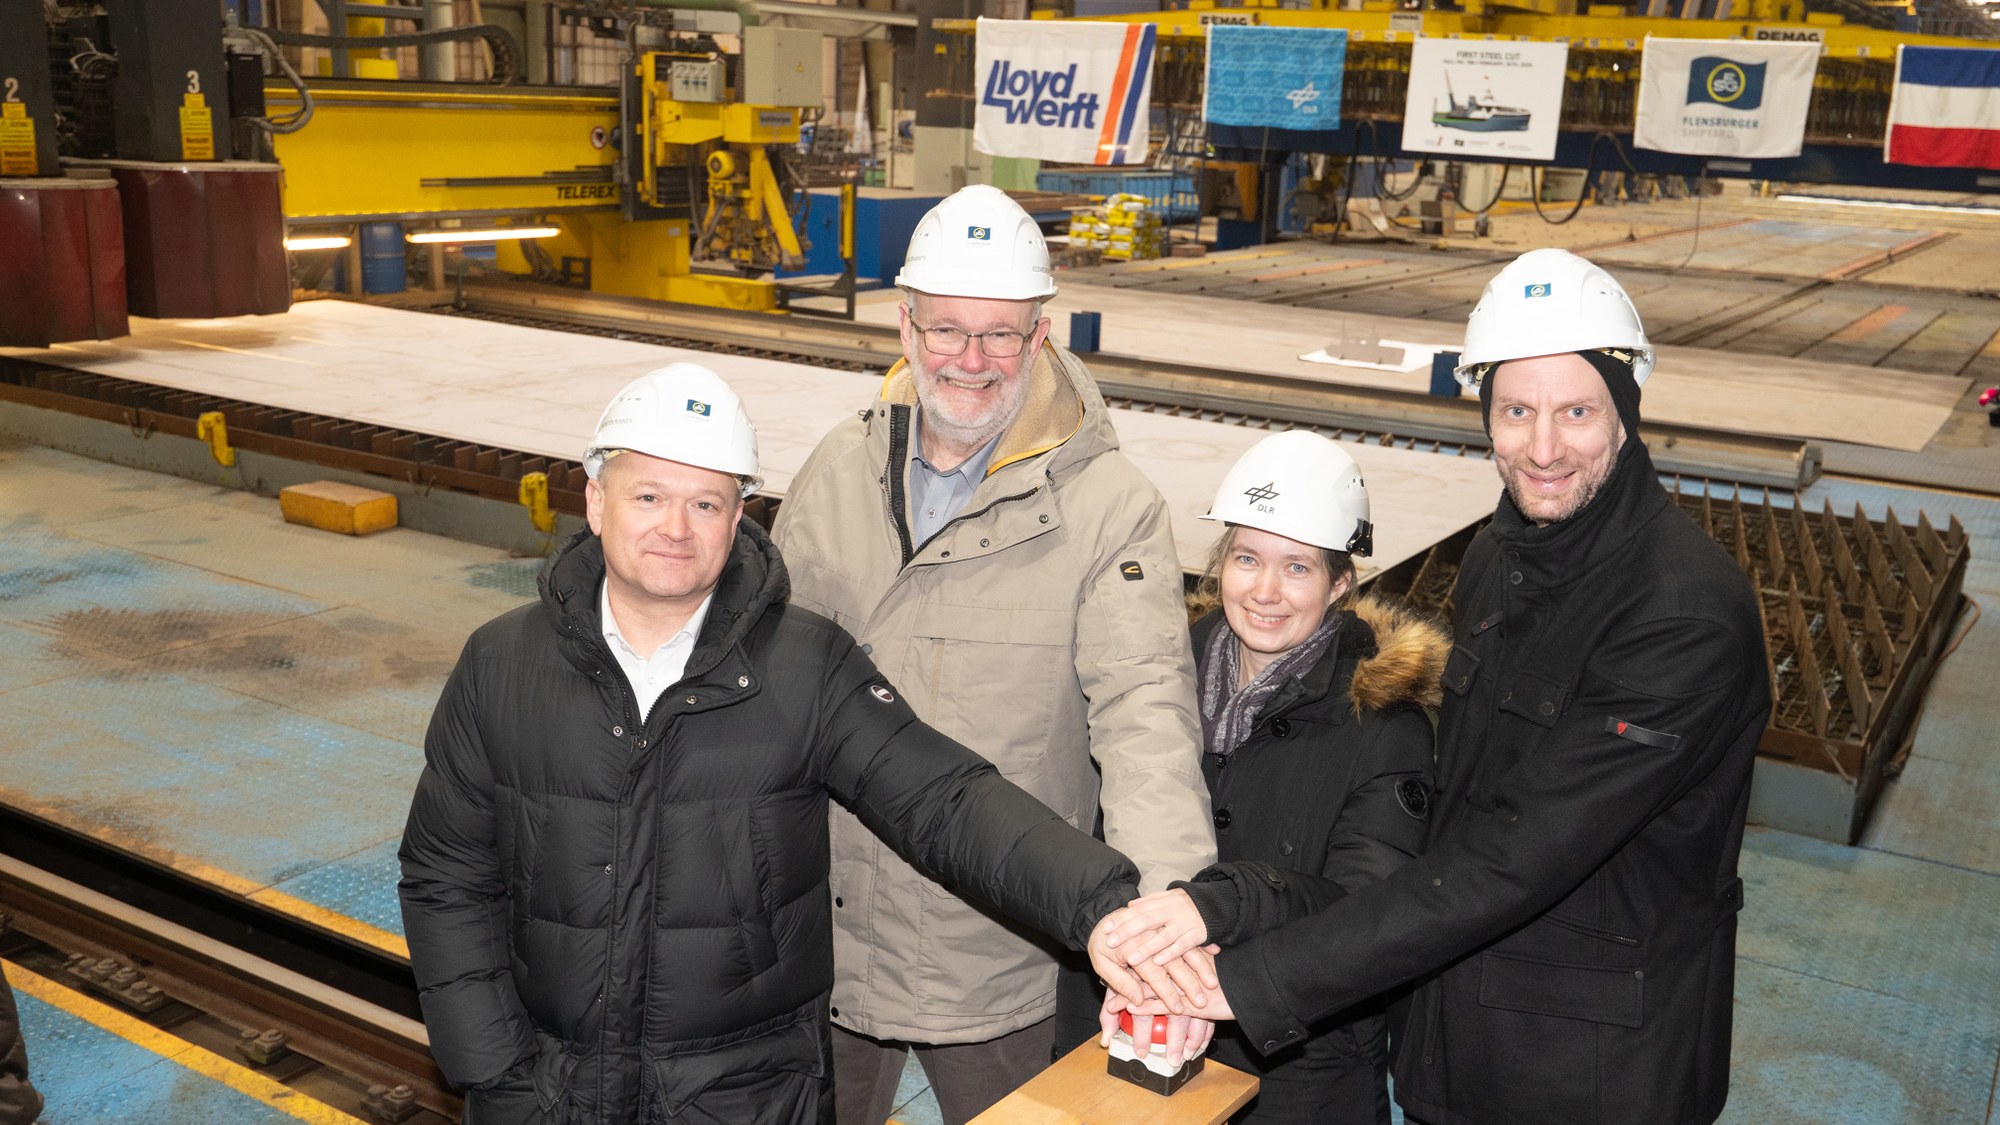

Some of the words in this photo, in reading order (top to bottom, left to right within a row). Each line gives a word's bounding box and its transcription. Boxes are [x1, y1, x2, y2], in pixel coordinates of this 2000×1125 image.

[1757, 29, 1819, 42] DEMAG
[4, 77, 20, 102] 2
[187, 70, 200, 93] 3
[983, 60, 1077, 107] Lloyd
[1006, 93, 1099, 129] werft
[1682, 116, 1759, 129] FLENSBURGER
[556, 185, 616, 199] TELEREX
[897, 409, 908, 440] MADE
[1257, 504, 1275, 514] DLR
